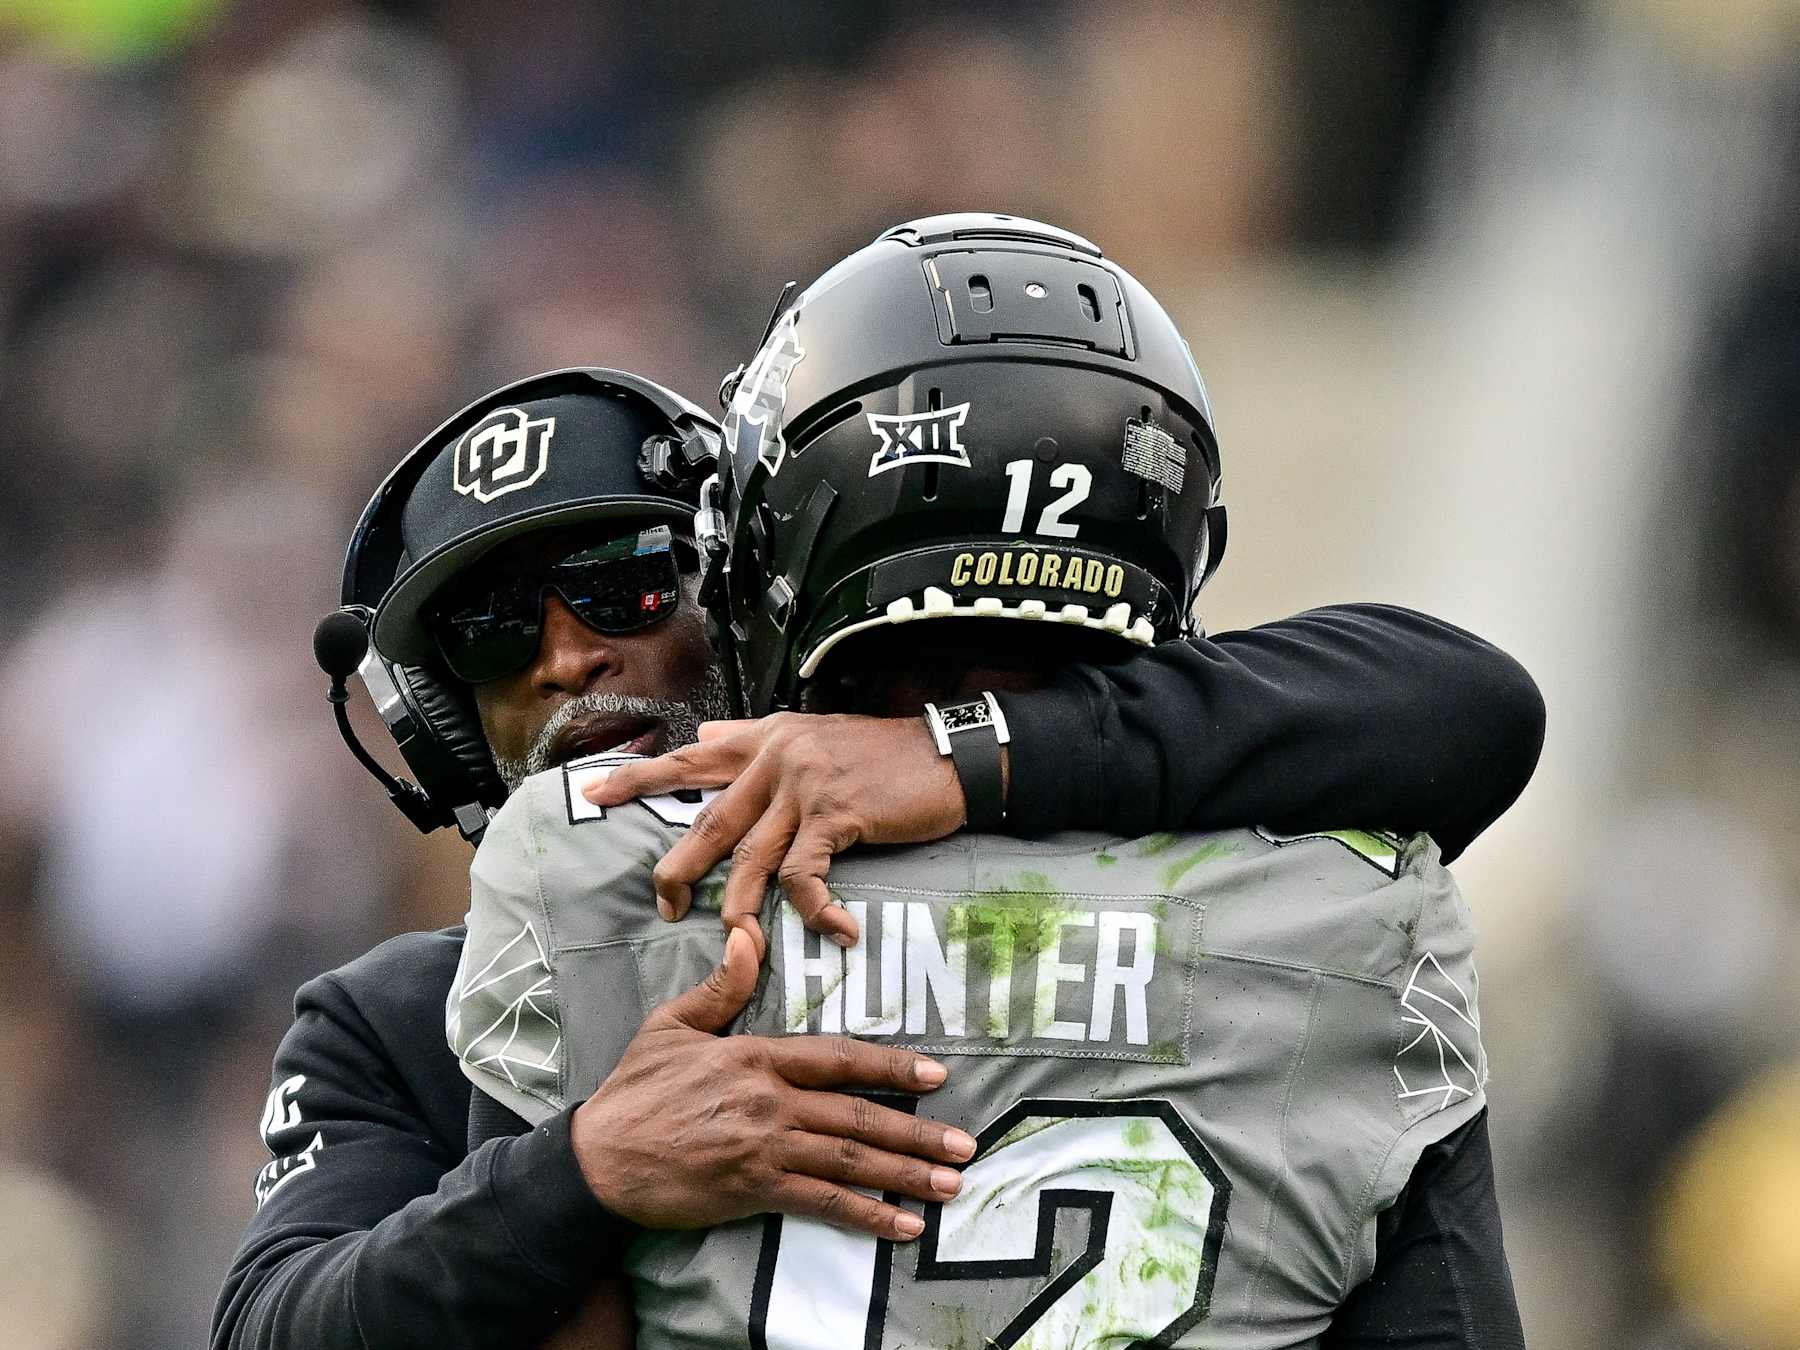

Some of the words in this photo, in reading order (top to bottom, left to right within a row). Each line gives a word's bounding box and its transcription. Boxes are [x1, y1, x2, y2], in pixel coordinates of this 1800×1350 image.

[453, 407, 556, 505] CU
[1001, 459, 1093, 539] 12
[950, 551, 1125, 598] COLORADO
[780, 899, 1158, 1046] HUNTER
